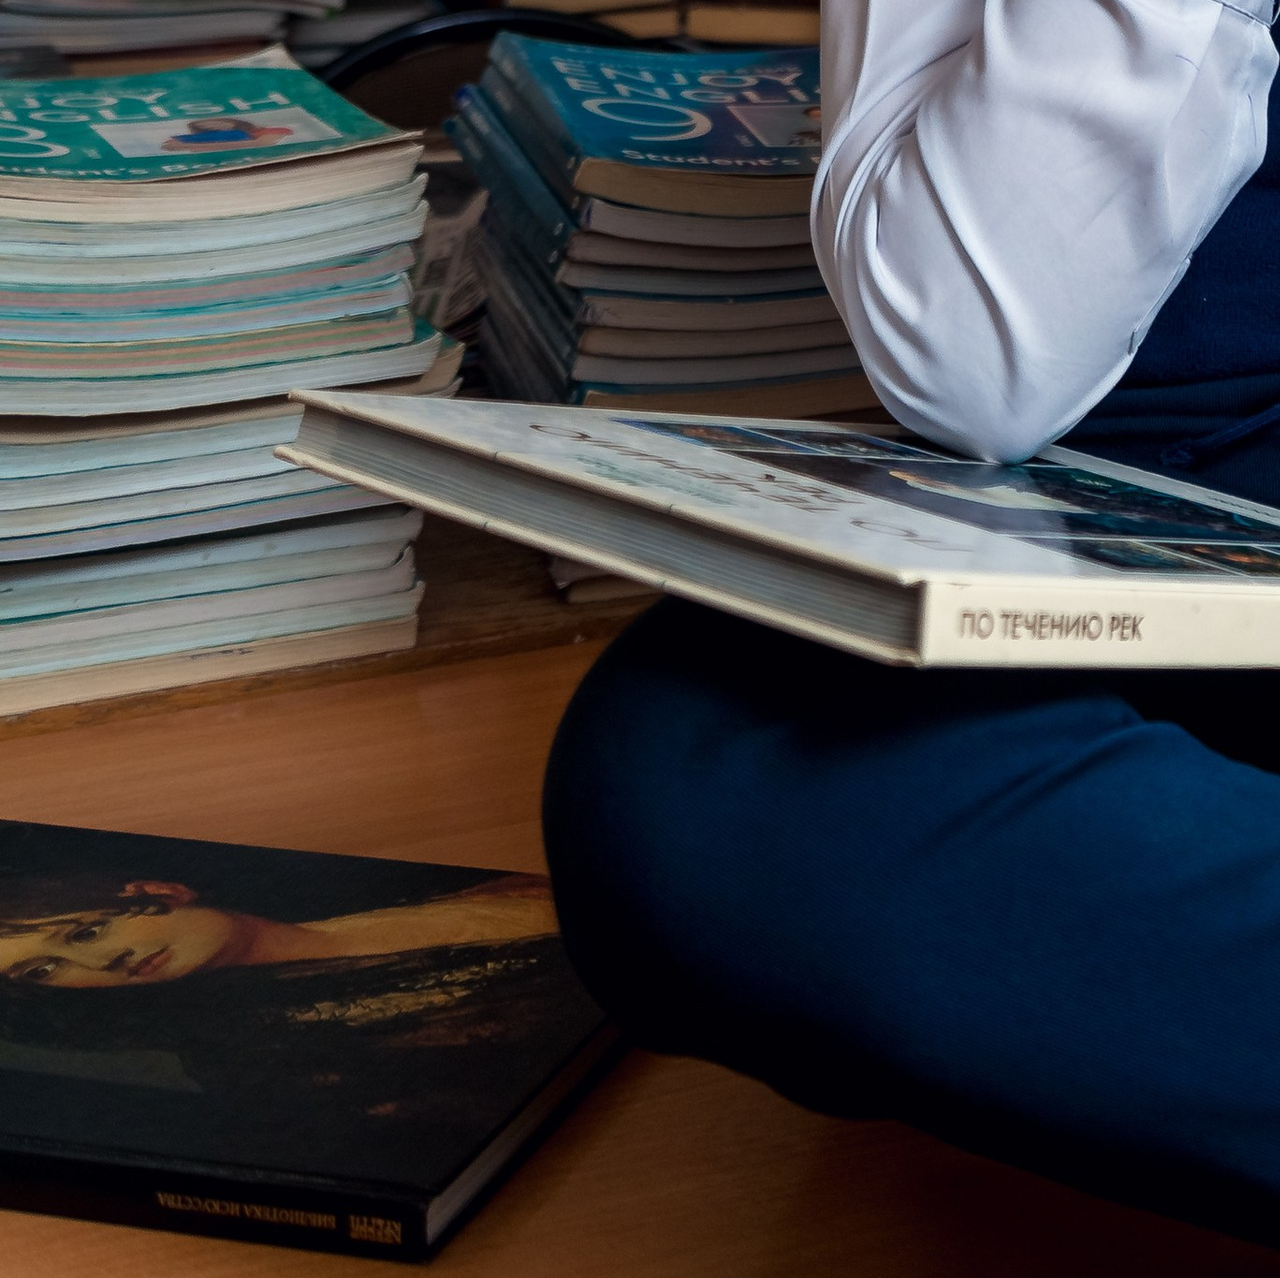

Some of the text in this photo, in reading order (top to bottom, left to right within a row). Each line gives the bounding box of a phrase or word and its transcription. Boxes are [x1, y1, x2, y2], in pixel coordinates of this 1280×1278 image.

[0, 88, 168, 109] JOY
[565, 77, 821, 103] ENGLI
[959, 609, 1144, 641] ПО ТЕЧЕНИЮ РЕК
